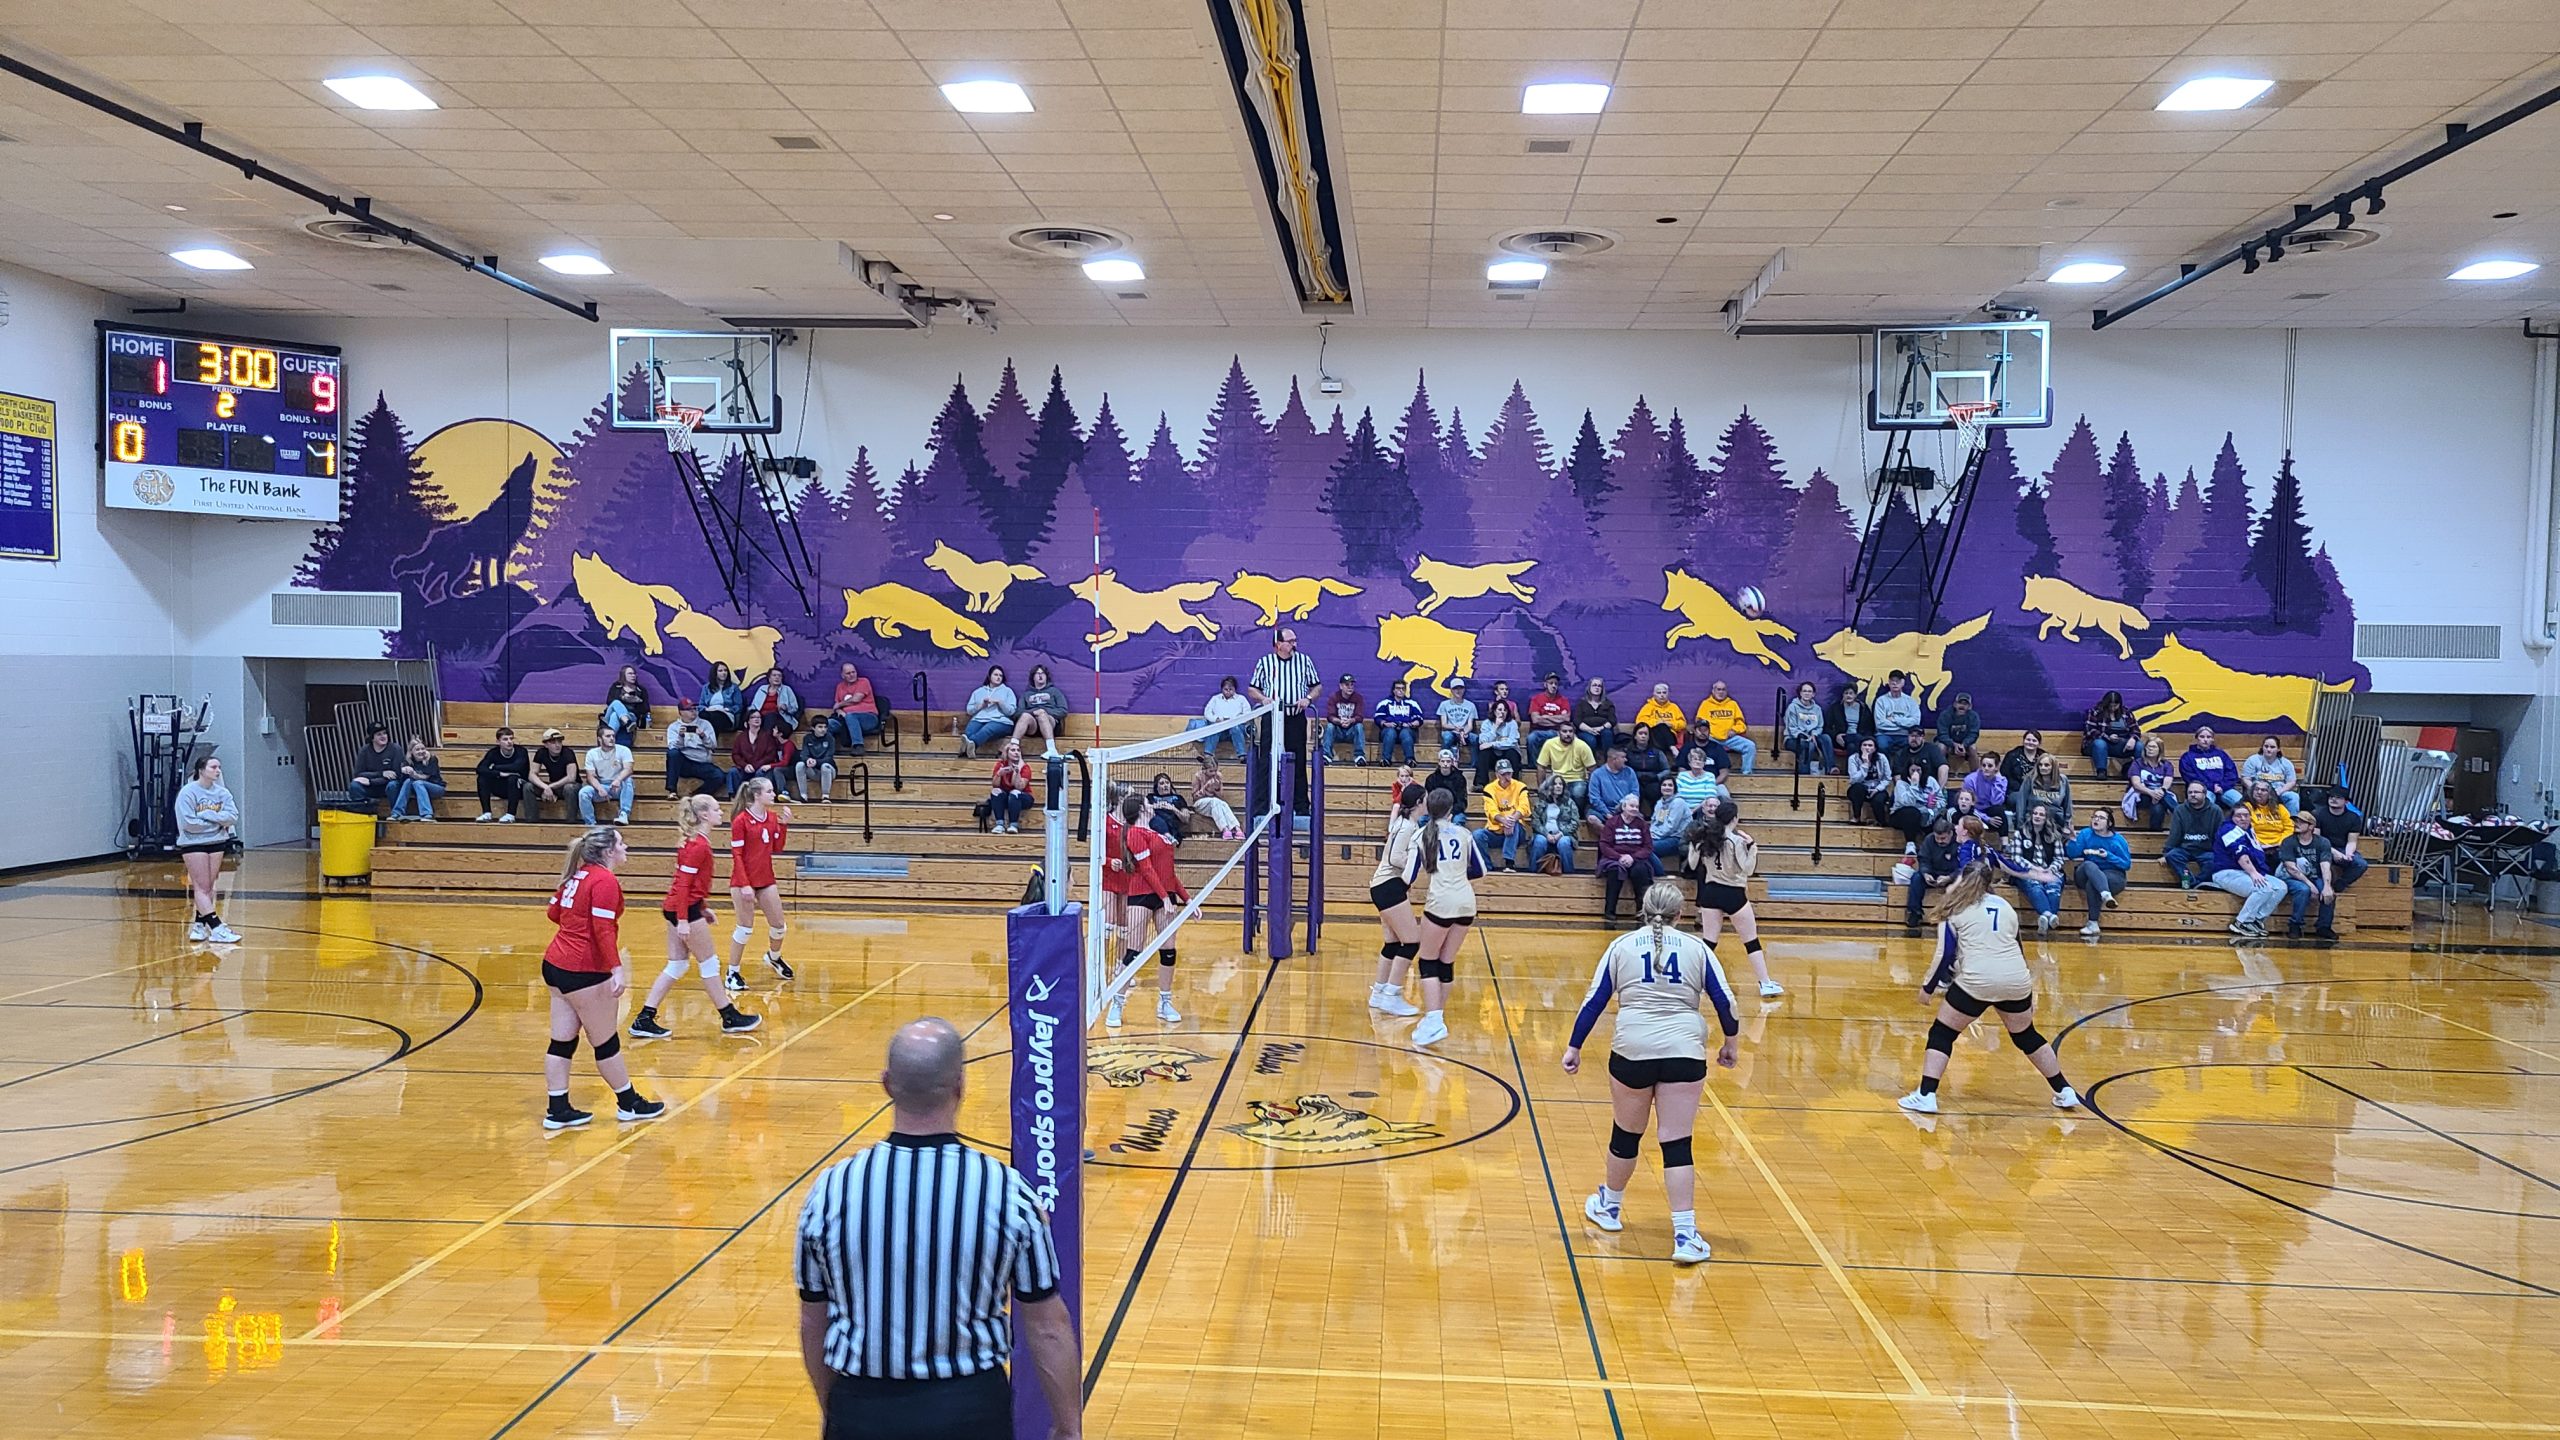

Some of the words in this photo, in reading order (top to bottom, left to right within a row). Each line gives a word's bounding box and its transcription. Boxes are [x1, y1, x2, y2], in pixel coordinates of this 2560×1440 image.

[112, 338, 164, 356] HOME
[155, 357, 167, 395] 1
[198, 343, 276, 390] 3:00
[283, 357, 337, 376] GUEST
[211, 386, 242, 395] PERIOD
[311, 374, 336, 412] 9
[139, 399, 173, 411] BONUS
[109, 412, 147, 424] FOULS
[206, 421, 247, 433] PLAYER
[280, 413, 310, 424] BONUS
[116, 421, 145, 463] 0
[303, 431, 337, 442] FOULS
[199, 477, 226, 493] The
[229, 479, 259, 495] FUN
[263, 481, 301, 498] Bank
[1438, 839, 1461, 861] 12
[1986, 907, 1999, 931] 7
[1641, 951, 1683, 984] 14
[1028, 1009, 1060, 1110] jaypro
[1031, 1116, 1060, 1213] sports
